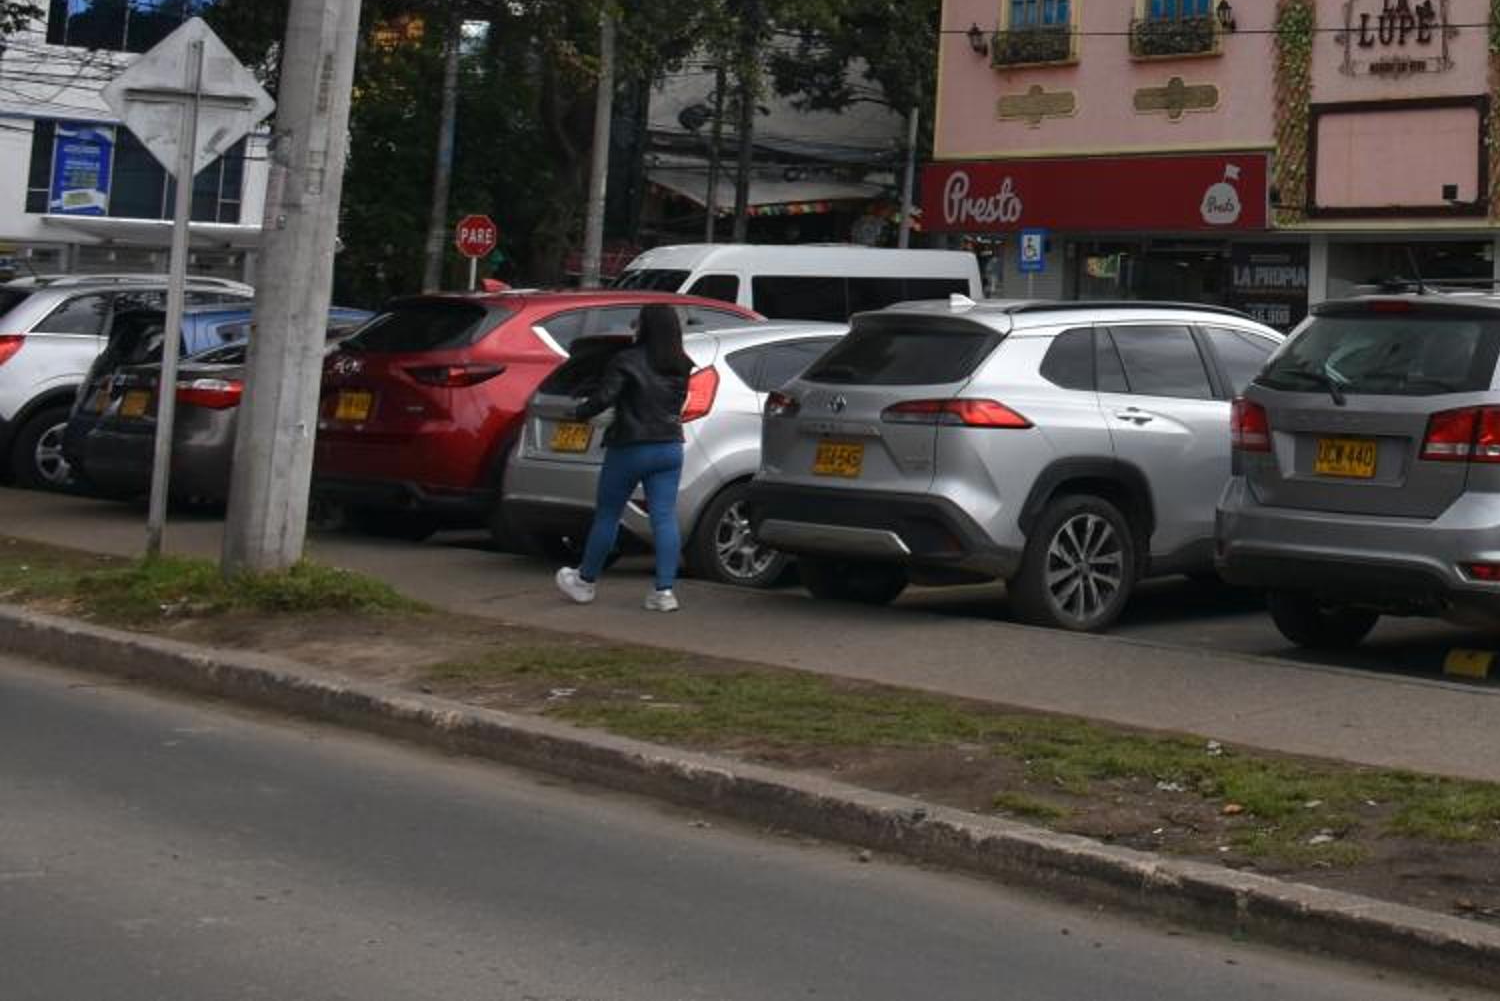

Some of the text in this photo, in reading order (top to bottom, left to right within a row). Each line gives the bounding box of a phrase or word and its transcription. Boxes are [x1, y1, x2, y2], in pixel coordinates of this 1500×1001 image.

[1358, 13, 1432, 48] LUPE
[943, 170, 1023, 224] Presto
[461, 228, 493, 244] PARE
